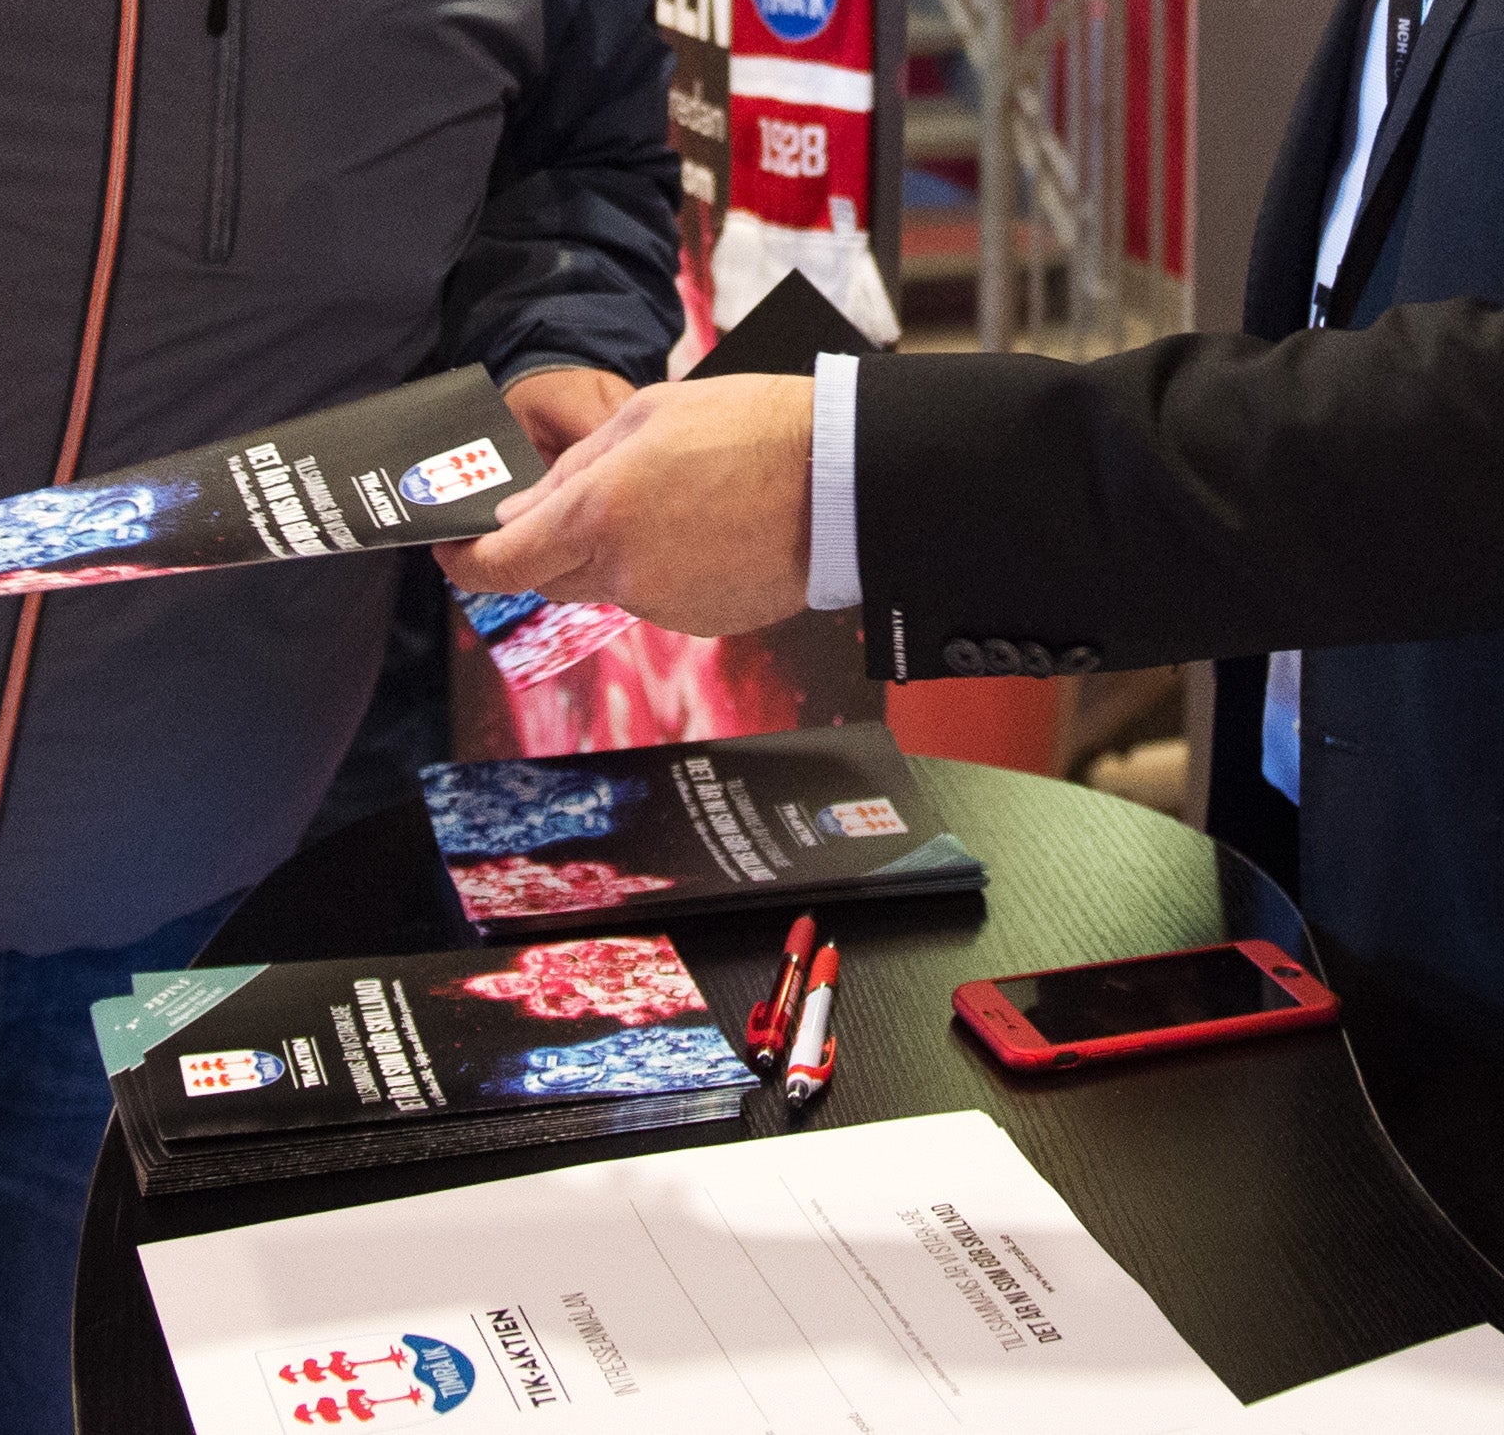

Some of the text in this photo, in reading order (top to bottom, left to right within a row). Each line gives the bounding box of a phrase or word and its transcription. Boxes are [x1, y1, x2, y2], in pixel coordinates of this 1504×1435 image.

[245, 442, 282, 470] DET
[255, 465, 291, 488] ÄR
[262, 482, 297, 501] NI
[269, 496, 308, 526] SOM
[685, 758, 716, 782] DET
[353, 978, 395, 1032] SKILLNAD
[367, 1031, 403, 1053] GÖR
[376, 1052, 411, 1076] SOM
[896, 1208, 951, 1254] STARKARE
[931, 1203, 1062, 1344] DET ÄR NI SOM GÖR SKILLNAD
[956, 1279, 1028, 1352] TILLSAMMANS
[421, 1344, 467, 1399] TIMRÅ IK
